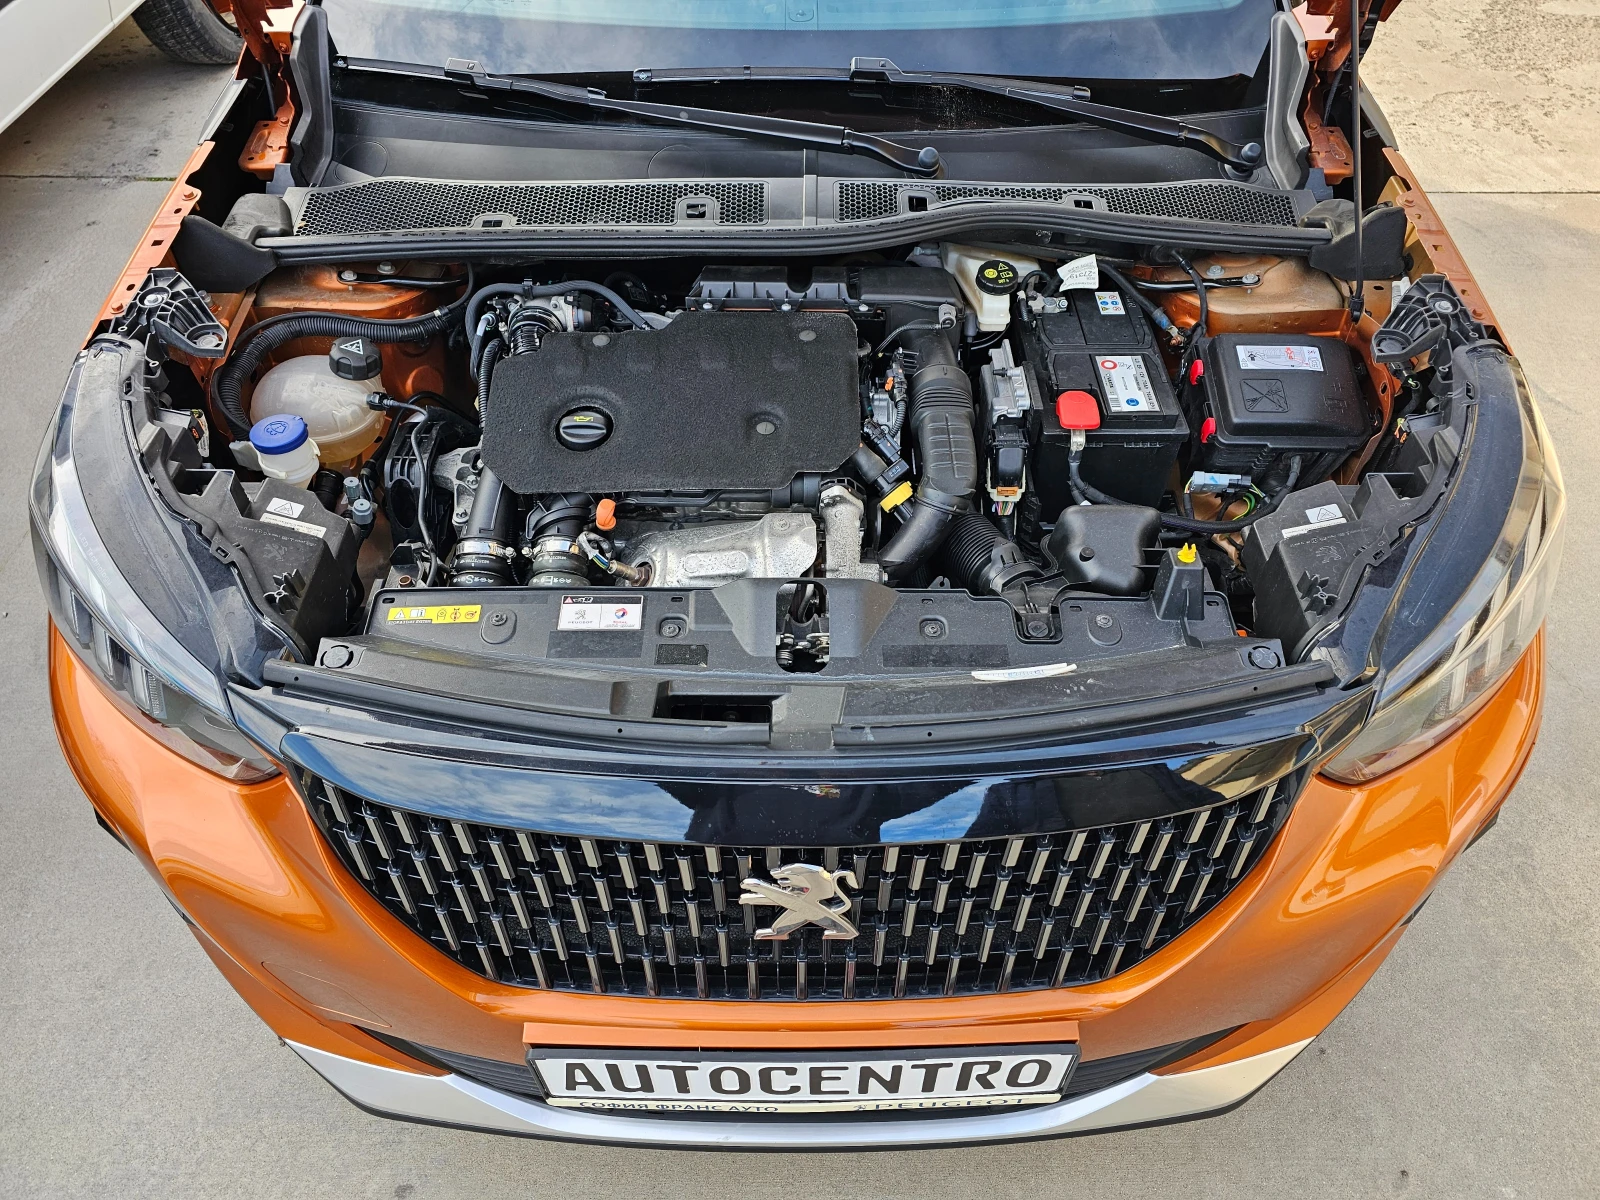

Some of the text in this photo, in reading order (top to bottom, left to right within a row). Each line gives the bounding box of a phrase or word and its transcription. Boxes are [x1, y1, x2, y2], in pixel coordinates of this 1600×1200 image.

[565, 1059, 1052, 1096] AUTOCENTRO
[579, 1101, 780, 1113] СОФИЯ ФРАНС АУТО
[874, 1098, 1032, 1111] PEUGEOT
